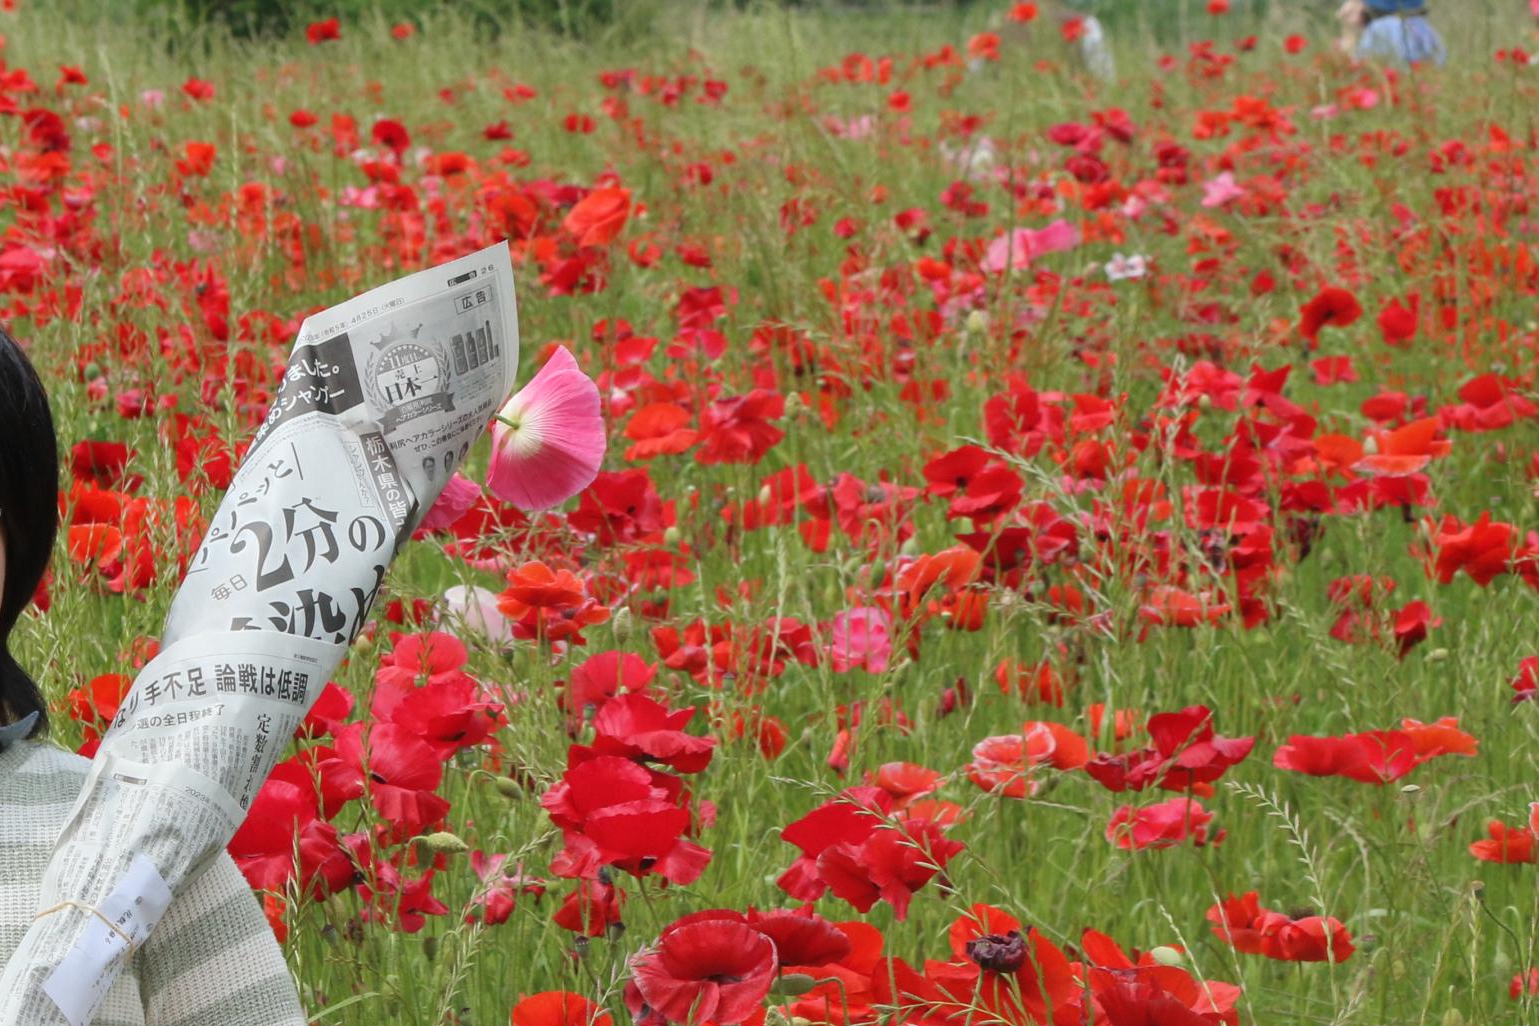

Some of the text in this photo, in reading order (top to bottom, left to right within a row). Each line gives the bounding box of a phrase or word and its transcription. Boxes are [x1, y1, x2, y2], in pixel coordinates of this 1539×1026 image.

[461, 290, 487, 310] 広告
[385, 376, 438, 405] 日本一
[214, 663, 308, 705] 論戦は低調
